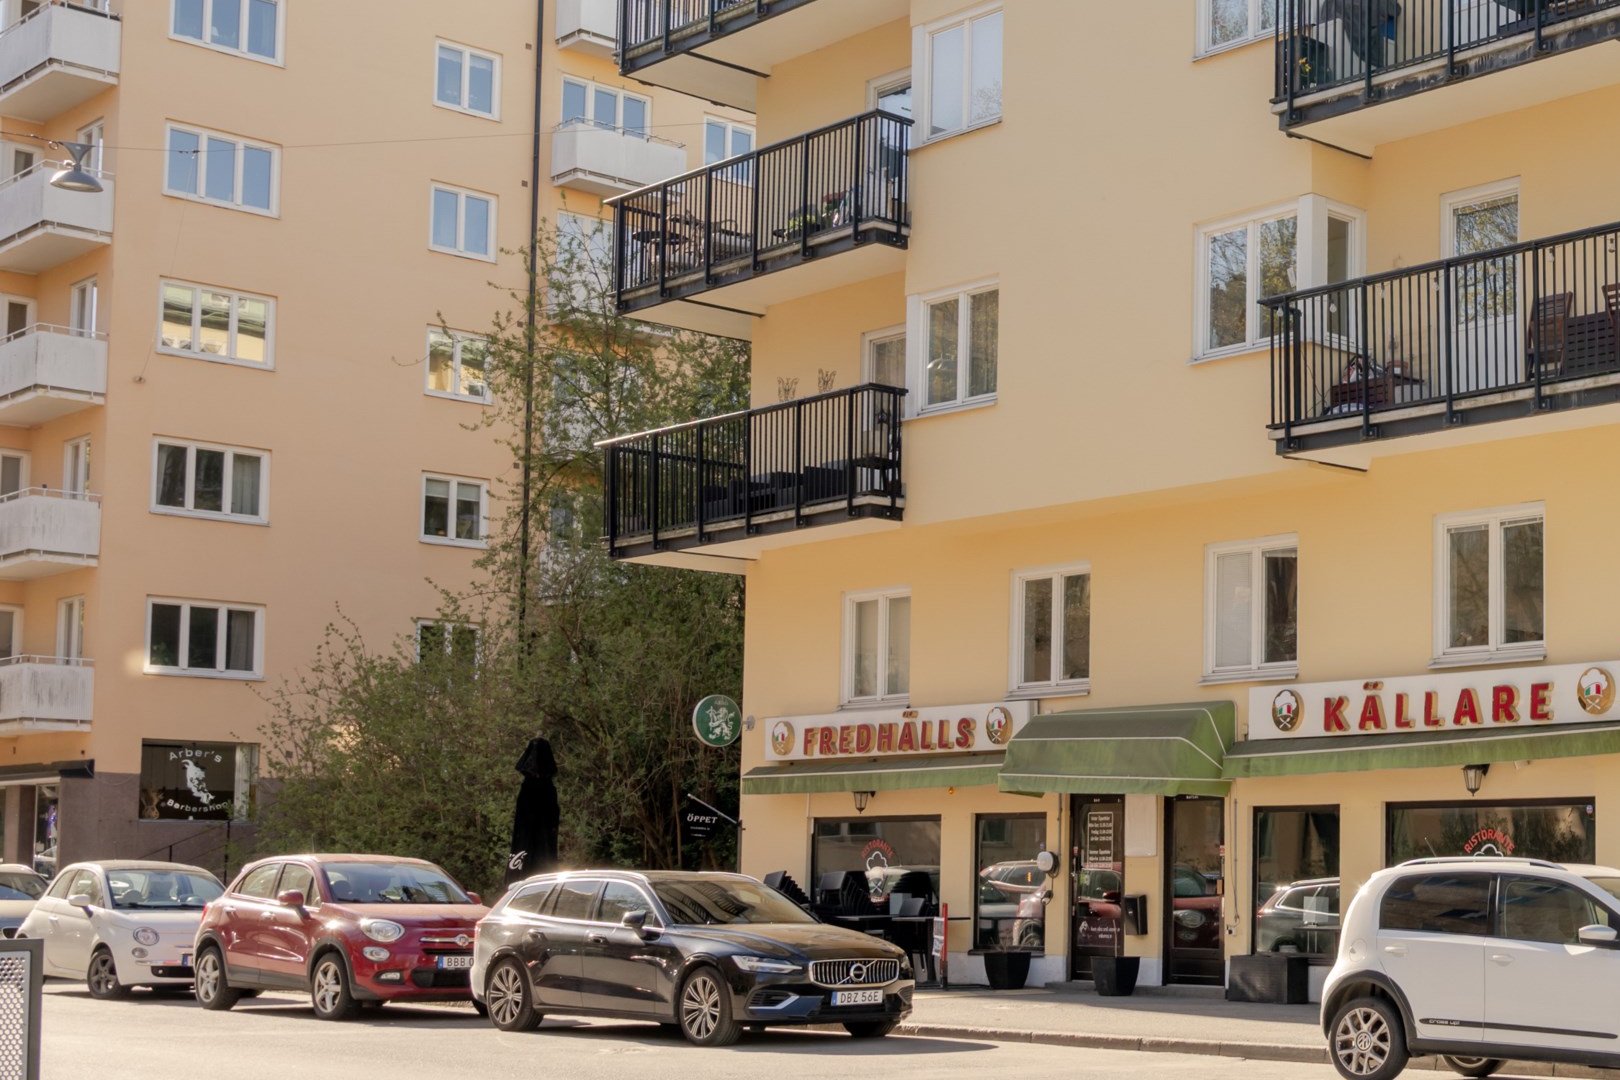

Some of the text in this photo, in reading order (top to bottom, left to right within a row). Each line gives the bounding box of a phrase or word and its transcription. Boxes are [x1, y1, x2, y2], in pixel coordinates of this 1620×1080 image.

[1323, 681, 1554, 732] KÄLLARE
[803, 710, 976, 756] FREDHÄLLS
[169, 748, 222, 763] Arber's
[686, 813, 718, 824] ÖPPET
[1464, 828, 1515, 856] RISTORANTE
[447, 957, 466, 967] BBB
[840, 991, 879, 1004] DBZ 56E
